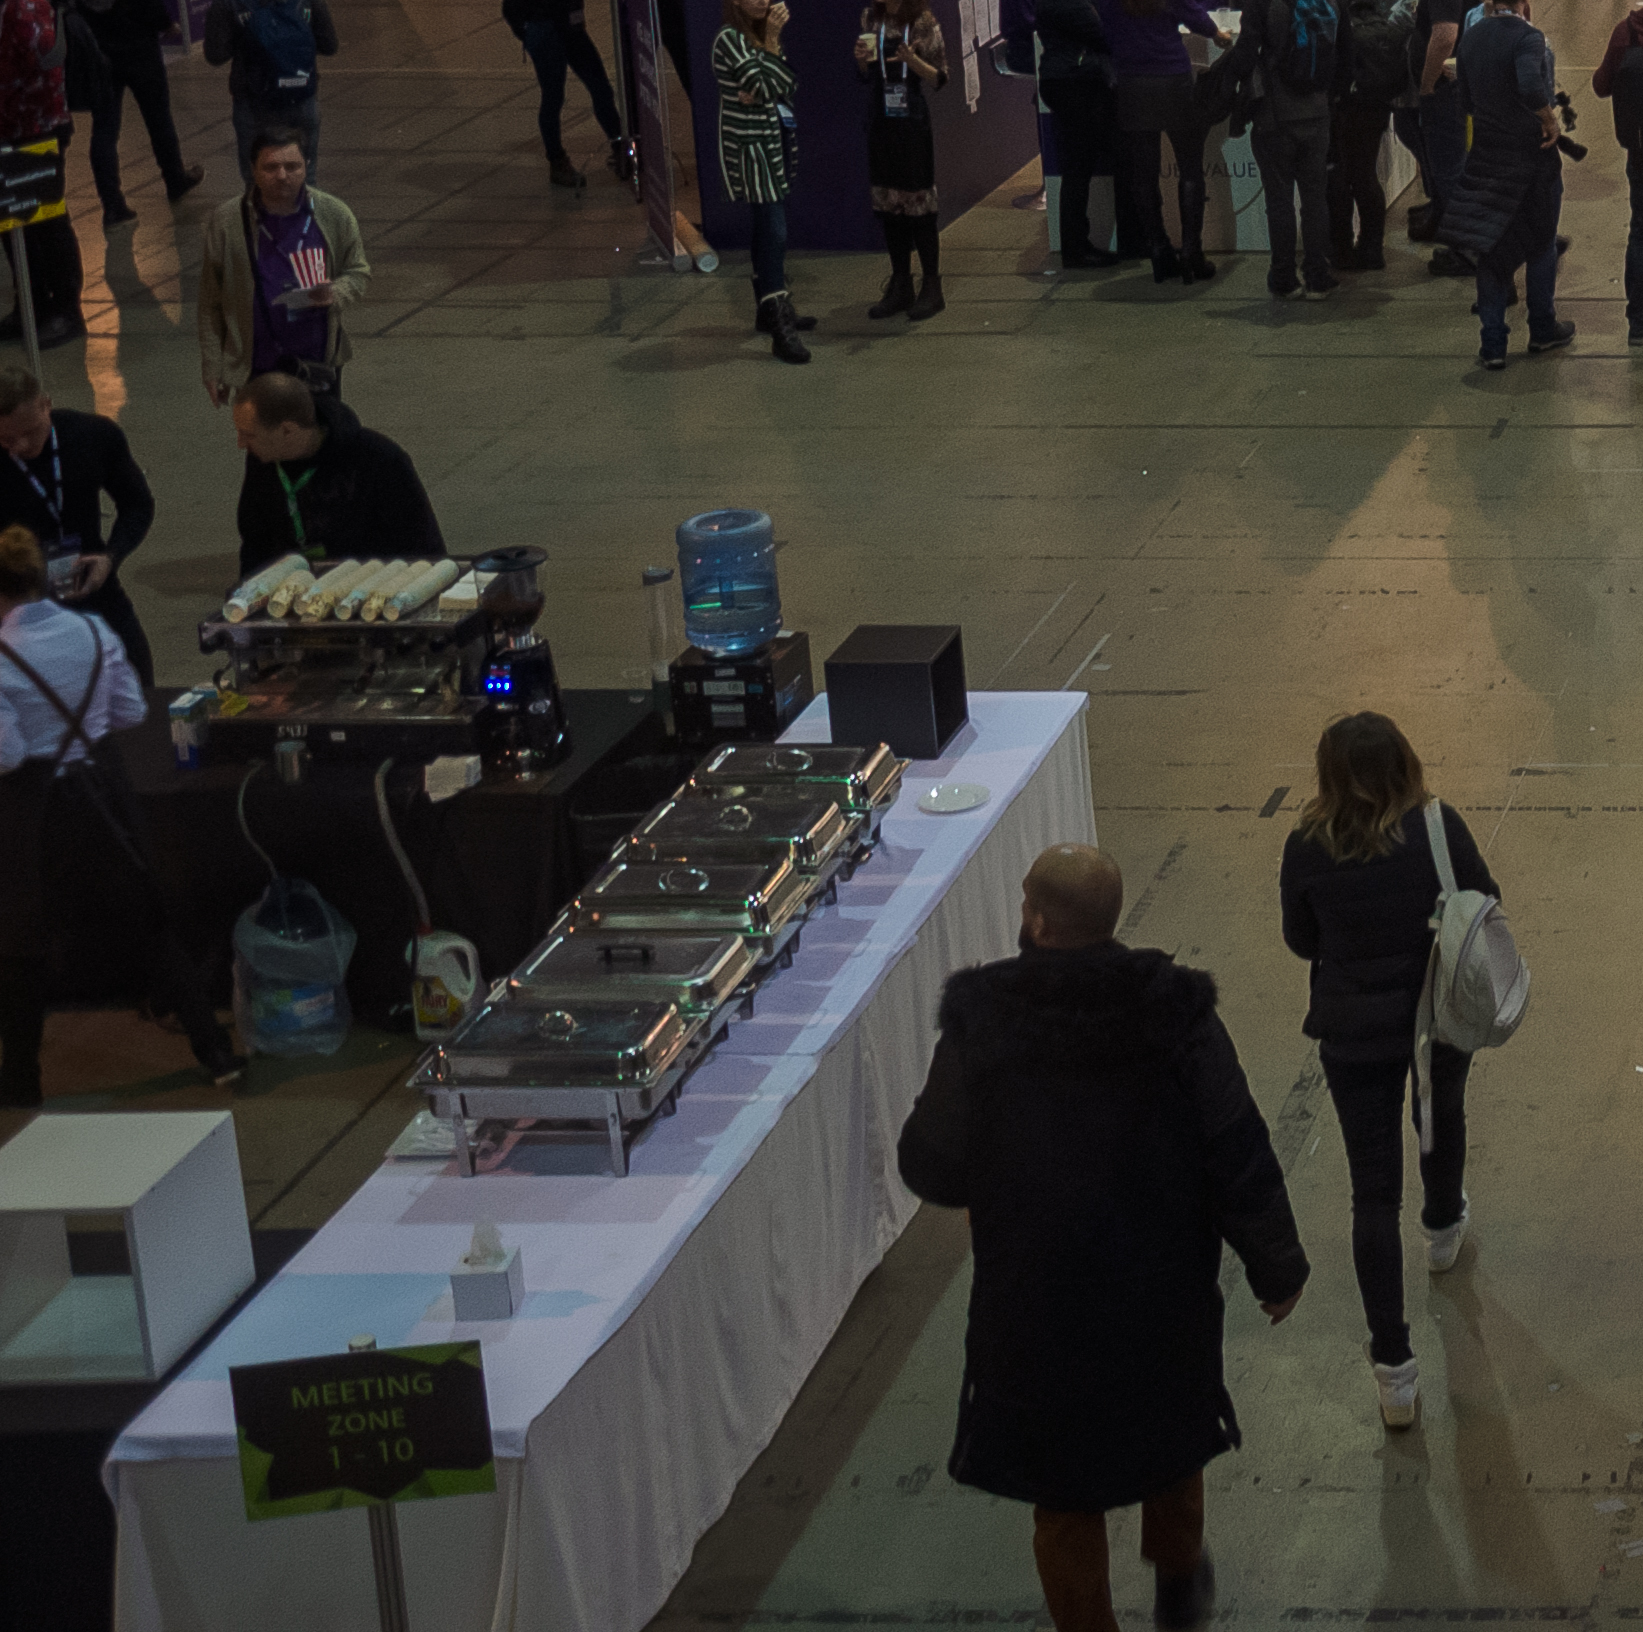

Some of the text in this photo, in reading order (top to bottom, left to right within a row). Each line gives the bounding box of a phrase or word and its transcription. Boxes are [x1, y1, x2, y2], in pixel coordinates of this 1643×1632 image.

[291, 1372, 434, 1409] MEETING
[327, 1408, 406, 1437] ZONE
[328, 1445, 341, 1469] 1
[378, 1437, 415, 1465] 10
